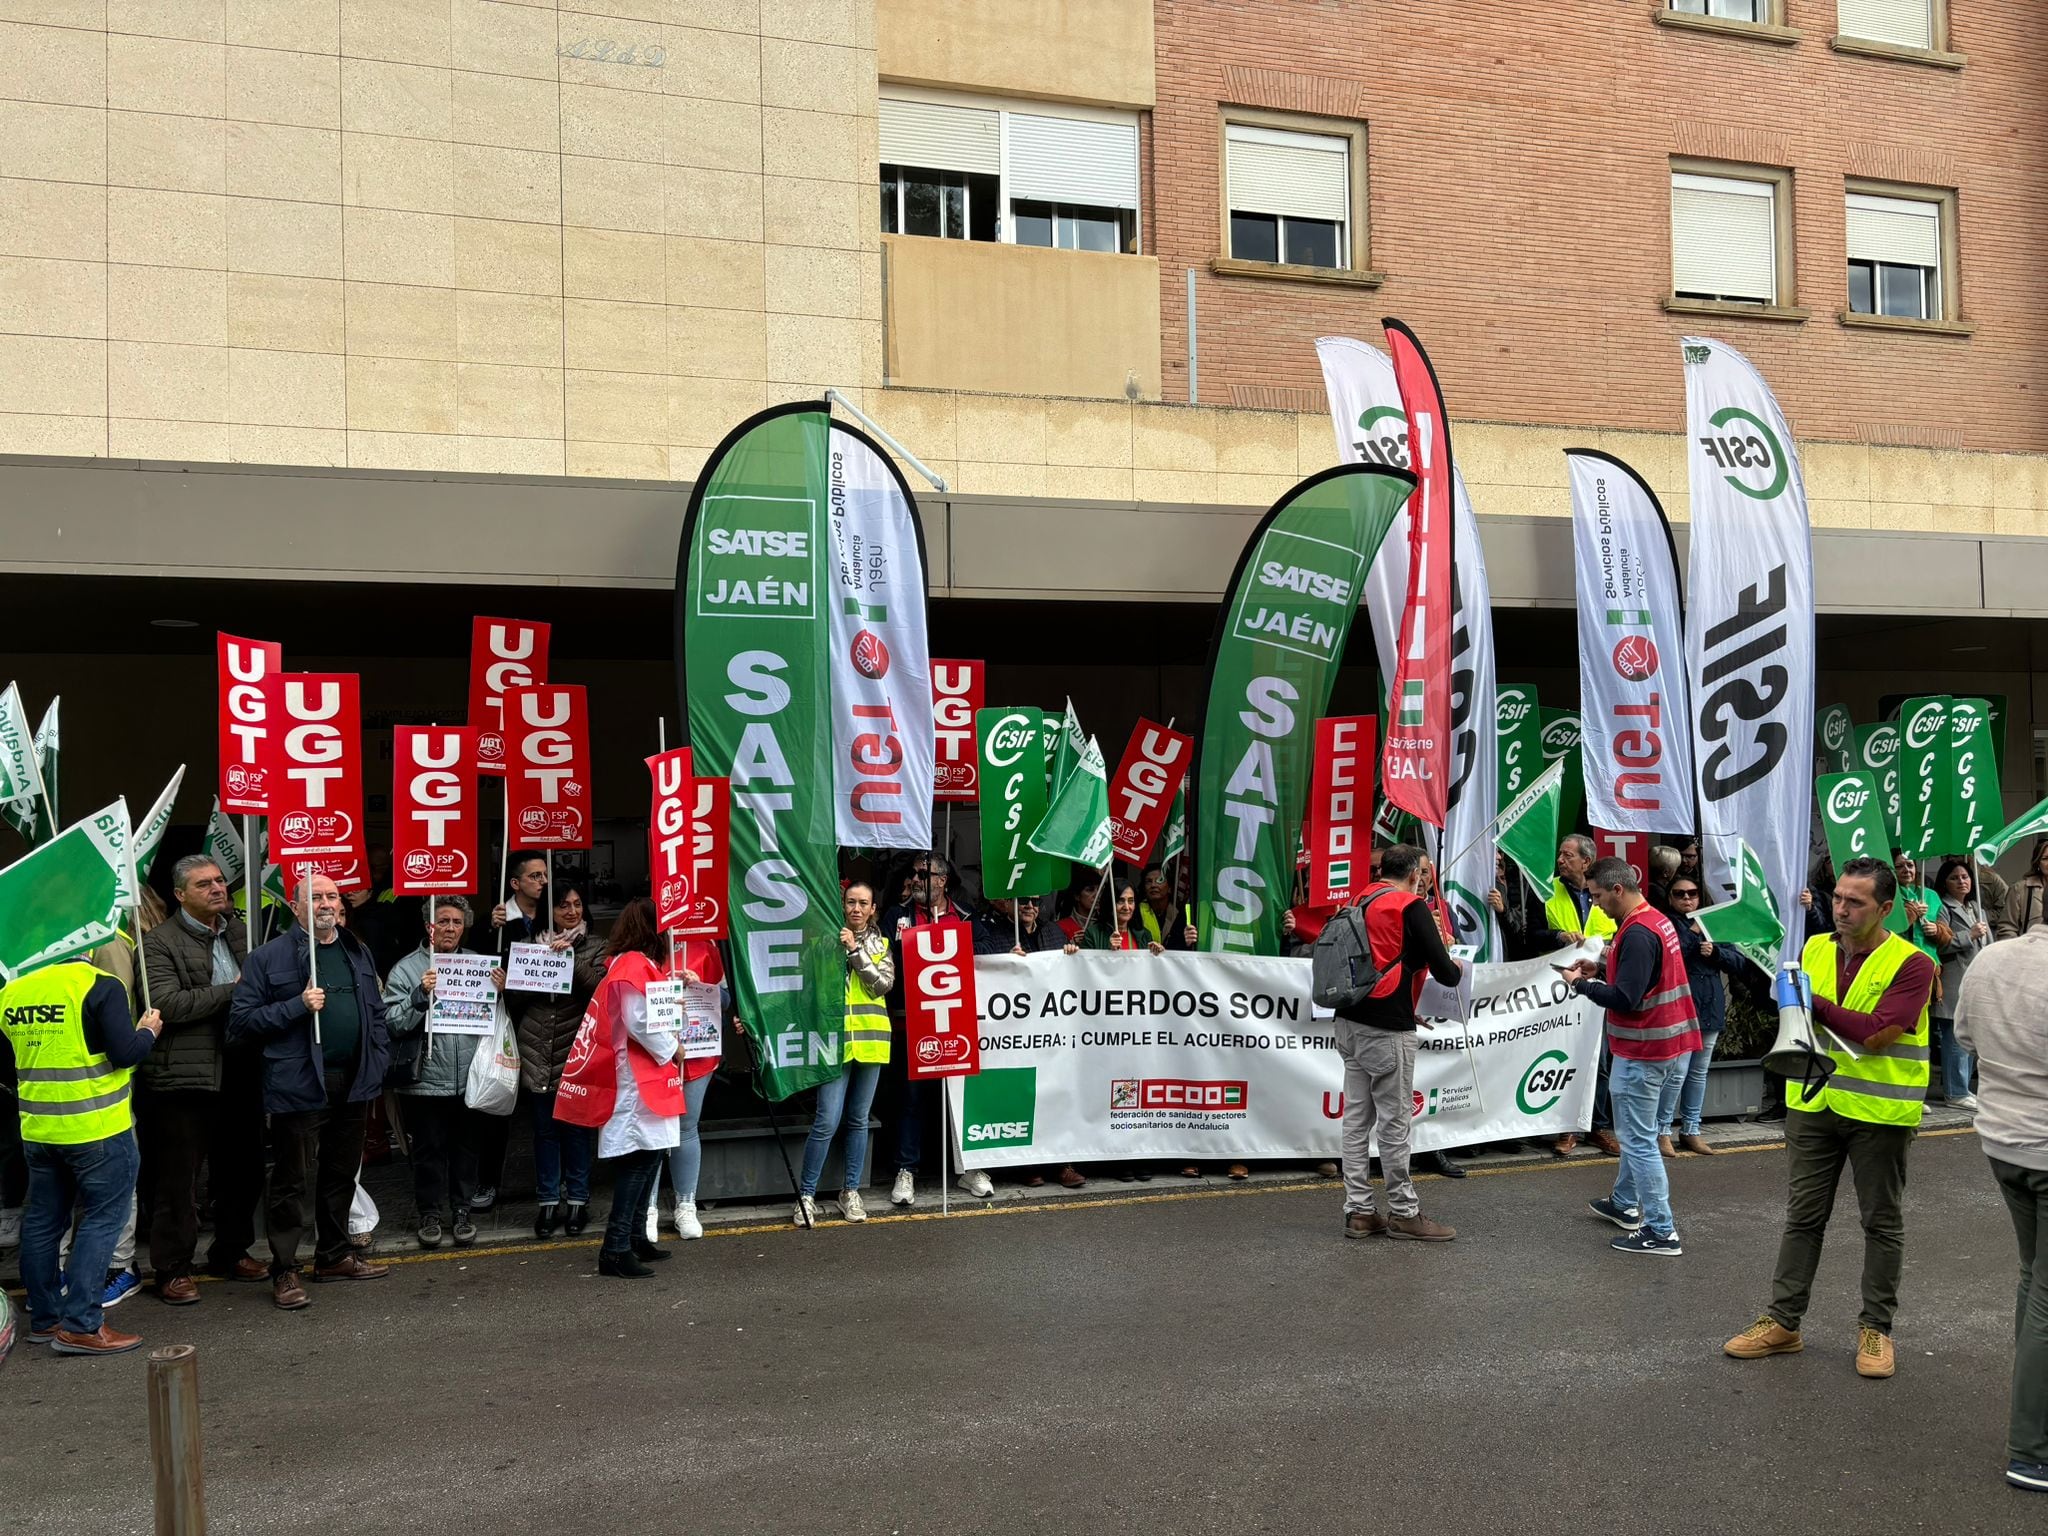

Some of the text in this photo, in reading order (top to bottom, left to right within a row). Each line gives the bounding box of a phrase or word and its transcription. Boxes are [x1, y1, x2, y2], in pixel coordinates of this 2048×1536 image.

[708, 528, 808, 557] SATSE
[706, 576, 808, 606] JAÉN
[1259, 561, 1350, 606] SATSE
[1244, 607, 1336, 650] JAÉN
[228, 642, 267, 764] UGT
[934, 665, 972, 760] UGT
[1497, 704, 1531, 720] CSIF
[1828, 718, 1847, 737] CSIF
[1914, 715, 1947, 733] CSIF
[285, 682, 343, 808] UGT
[480, 737, 501, 749] UGT
[521, 693, 574, 803] UGT
[996, 730, 1036, 748] CSIF
[953, 767, 966, 775] FSP
[1121, 728, 1183, 823] UGT
[1505, 740, 1522, 792] CS
[229, 770, 264, 784] UGT FSP
[410, 734, 461, 846] UGT
[1835, 791, 1870, 809] CSIF
[1919, 752, 1935, 852] CSIF
[1958, 752, 1983, 848] CSIF
[284, 816, 337, 832] UGT FSP
[524, 811, 569, 822] UGT FSP
[657, 757, 684, 876] UGT
[724, 650, 808, 994] SATSE
[1005, 772, 1027, 890] CSIF
[1125, 828, 1139, 838] FSP
[408, 854, 454, 866] UGT FSP
[1327, 889, 1350, 900] Jaén
[695, 901, 706, 911] SP
[515, 957, 567, 968] NO AL ROBO
[437, 967, 491, 978] NO AL ROBO
[524, 969, 558, 978] DEL CRP
[916, 929, 963, 1033] UGT
[447, 979, 482, 988] DEL CRP
[1040, 989, 1219, 1018] ACUERDOS
[1230, 992, 1299, 1021] SON
[4, 1004, 66, 1026] SATSE
[978, 1033, 1066, 1050] ONSEJERA:
[1081, 1031, 1151, 1046] CUMPLE
[1157, 1031, 1178, 1045] EL
[1184, 1033, 1270, 1049] ACUERDO
[1276, 1036, 1297, 1049] DE
[1419, 1035, 1485, 1051] ARRERA
[1489, 1014, 1573, 1045] PROFESIONAL
[763, 1023, 839, 1069] AÉN
[919, 1040, 959, 1052] UGT FSP
[560, 1080, 587, 1096] mano
[1442, 1085, 1473, 1095] Servicios
[1528, 1068, 1577, 1093] CSIF
[1147, 1085, 1222, 1104] CCOO
[1441, 1095, 1470, 1104] Públicos
[1110, 1110, 1154, 1119] federación
[1156, 1110, 1166, 1118] de
[1169, 1111, 1203, 1120] sanidad
[1204, 1113, 1210, 1121] y
[1440, 1102, 1472, 1112] Andalucía
[967, 1121, 1030, 1143] SATSE
[1110, 1121, 1230, 1130] sociosanitarios de Andalucía
